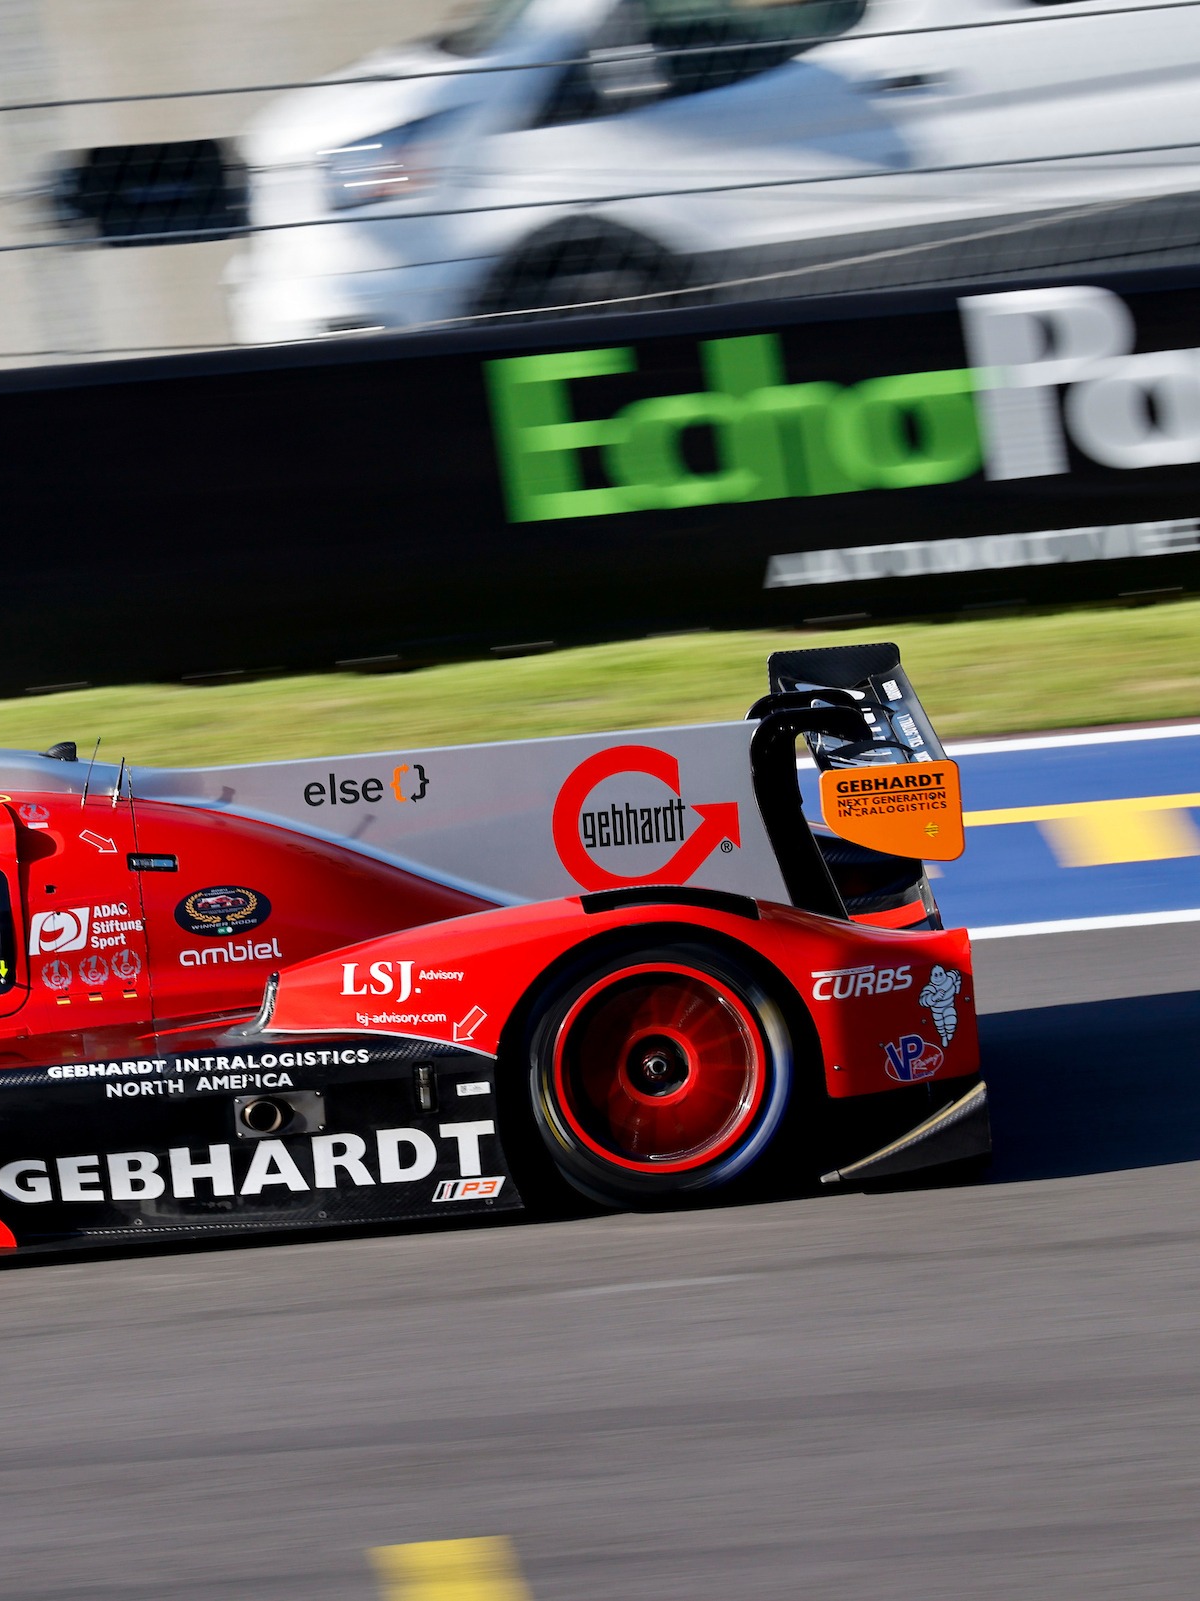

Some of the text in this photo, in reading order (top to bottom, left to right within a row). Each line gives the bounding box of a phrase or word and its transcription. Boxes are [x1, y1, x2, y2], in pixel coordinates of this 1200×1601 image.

[836, 773, 944, 794] GEBHARDT
[837, 791, 946, 808] NEXT GENERATION
[583, 798, 686, 848] gebhardt
[93, 902, 128, 918] ADAC
[92, 919, 145, 935] Stiftung
[191, 918, 258, 931] WINNER MODE
[90, 933, 127, 949] Sport
[179, 937, 282, 966] ambiel
[419, 970, 465, 982] Advisory
[812, 965, 914, 1001] CURBS
[356, 1011, 447, 1026] lsj-advisory.com
[47, 1049, 370, 1079] GEBHARDT INTRALOGISTICS
[884, 1033, 925, 1081] VP
[106, 1072, 294, 1098] NORTH AMERICA
[461, 1180, 498, 1196] P3
